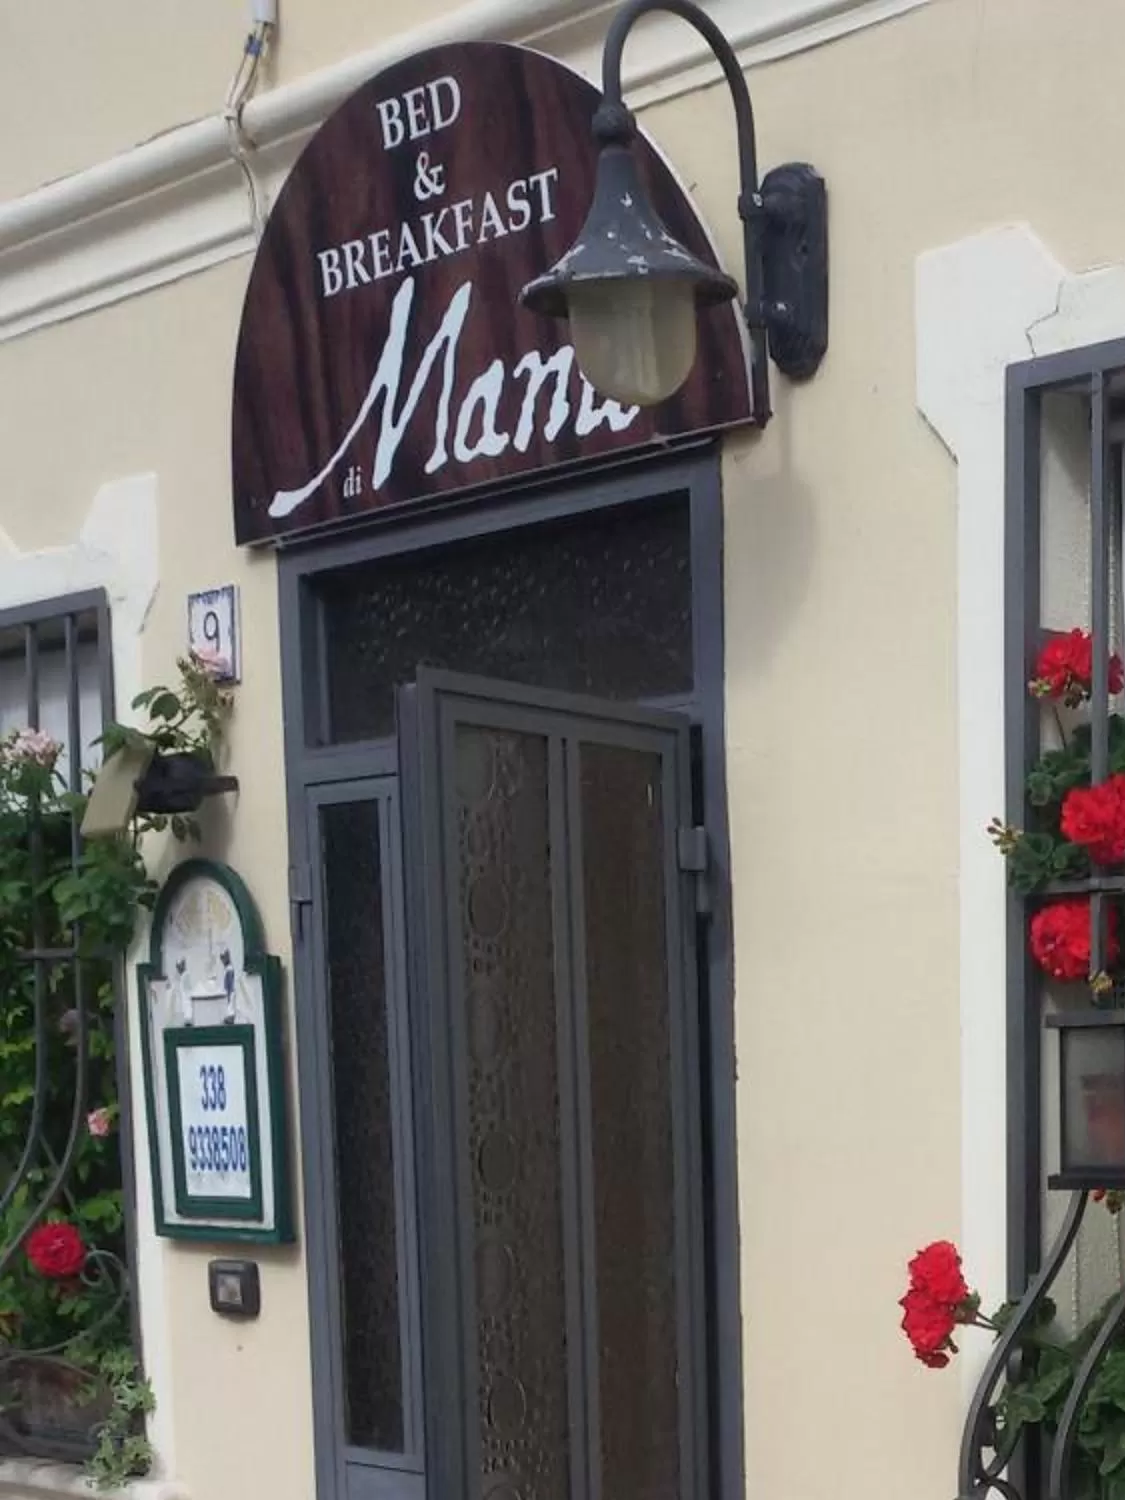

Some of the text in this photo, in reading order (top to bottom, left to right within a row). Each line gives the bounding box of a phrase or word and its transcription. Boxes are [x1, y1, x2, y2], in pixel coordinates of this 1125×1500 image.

[376, 74, 462, 151] BED
[413, 151, 446, 201] &
[317, 168, 560, 298] BREAKFAST
[342, 467, 363, 498] di
[203, 610, 220, 653] 9
[200, 1064, 227, 1112] 338
